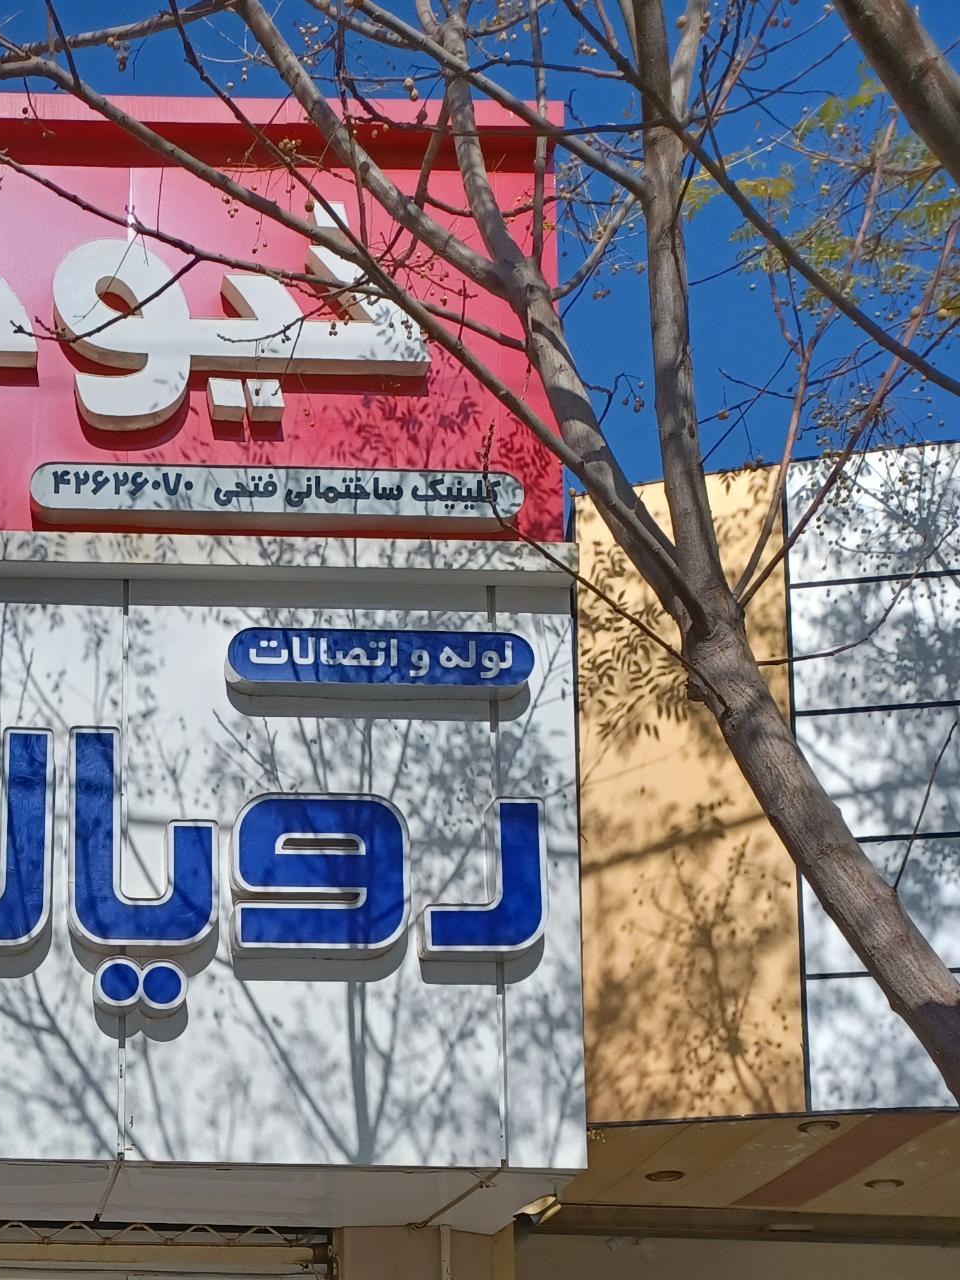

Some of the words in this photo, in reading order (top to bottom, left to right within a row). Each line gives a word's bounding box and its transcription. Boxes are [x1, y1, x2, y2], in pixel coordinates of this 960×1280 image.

[52, 469, 194, 496] ۴۲۶۲۶۰۷۰
[214, 473, 278, 506] فتحی
[285, 475, 404, 507] ساختمانی
[411, 478, 501, 510] کلینیک
[249, 636, 398, 667] اتصالات
[409, 649, 430, 677] و
[439, 640, 513, 679] لوله
